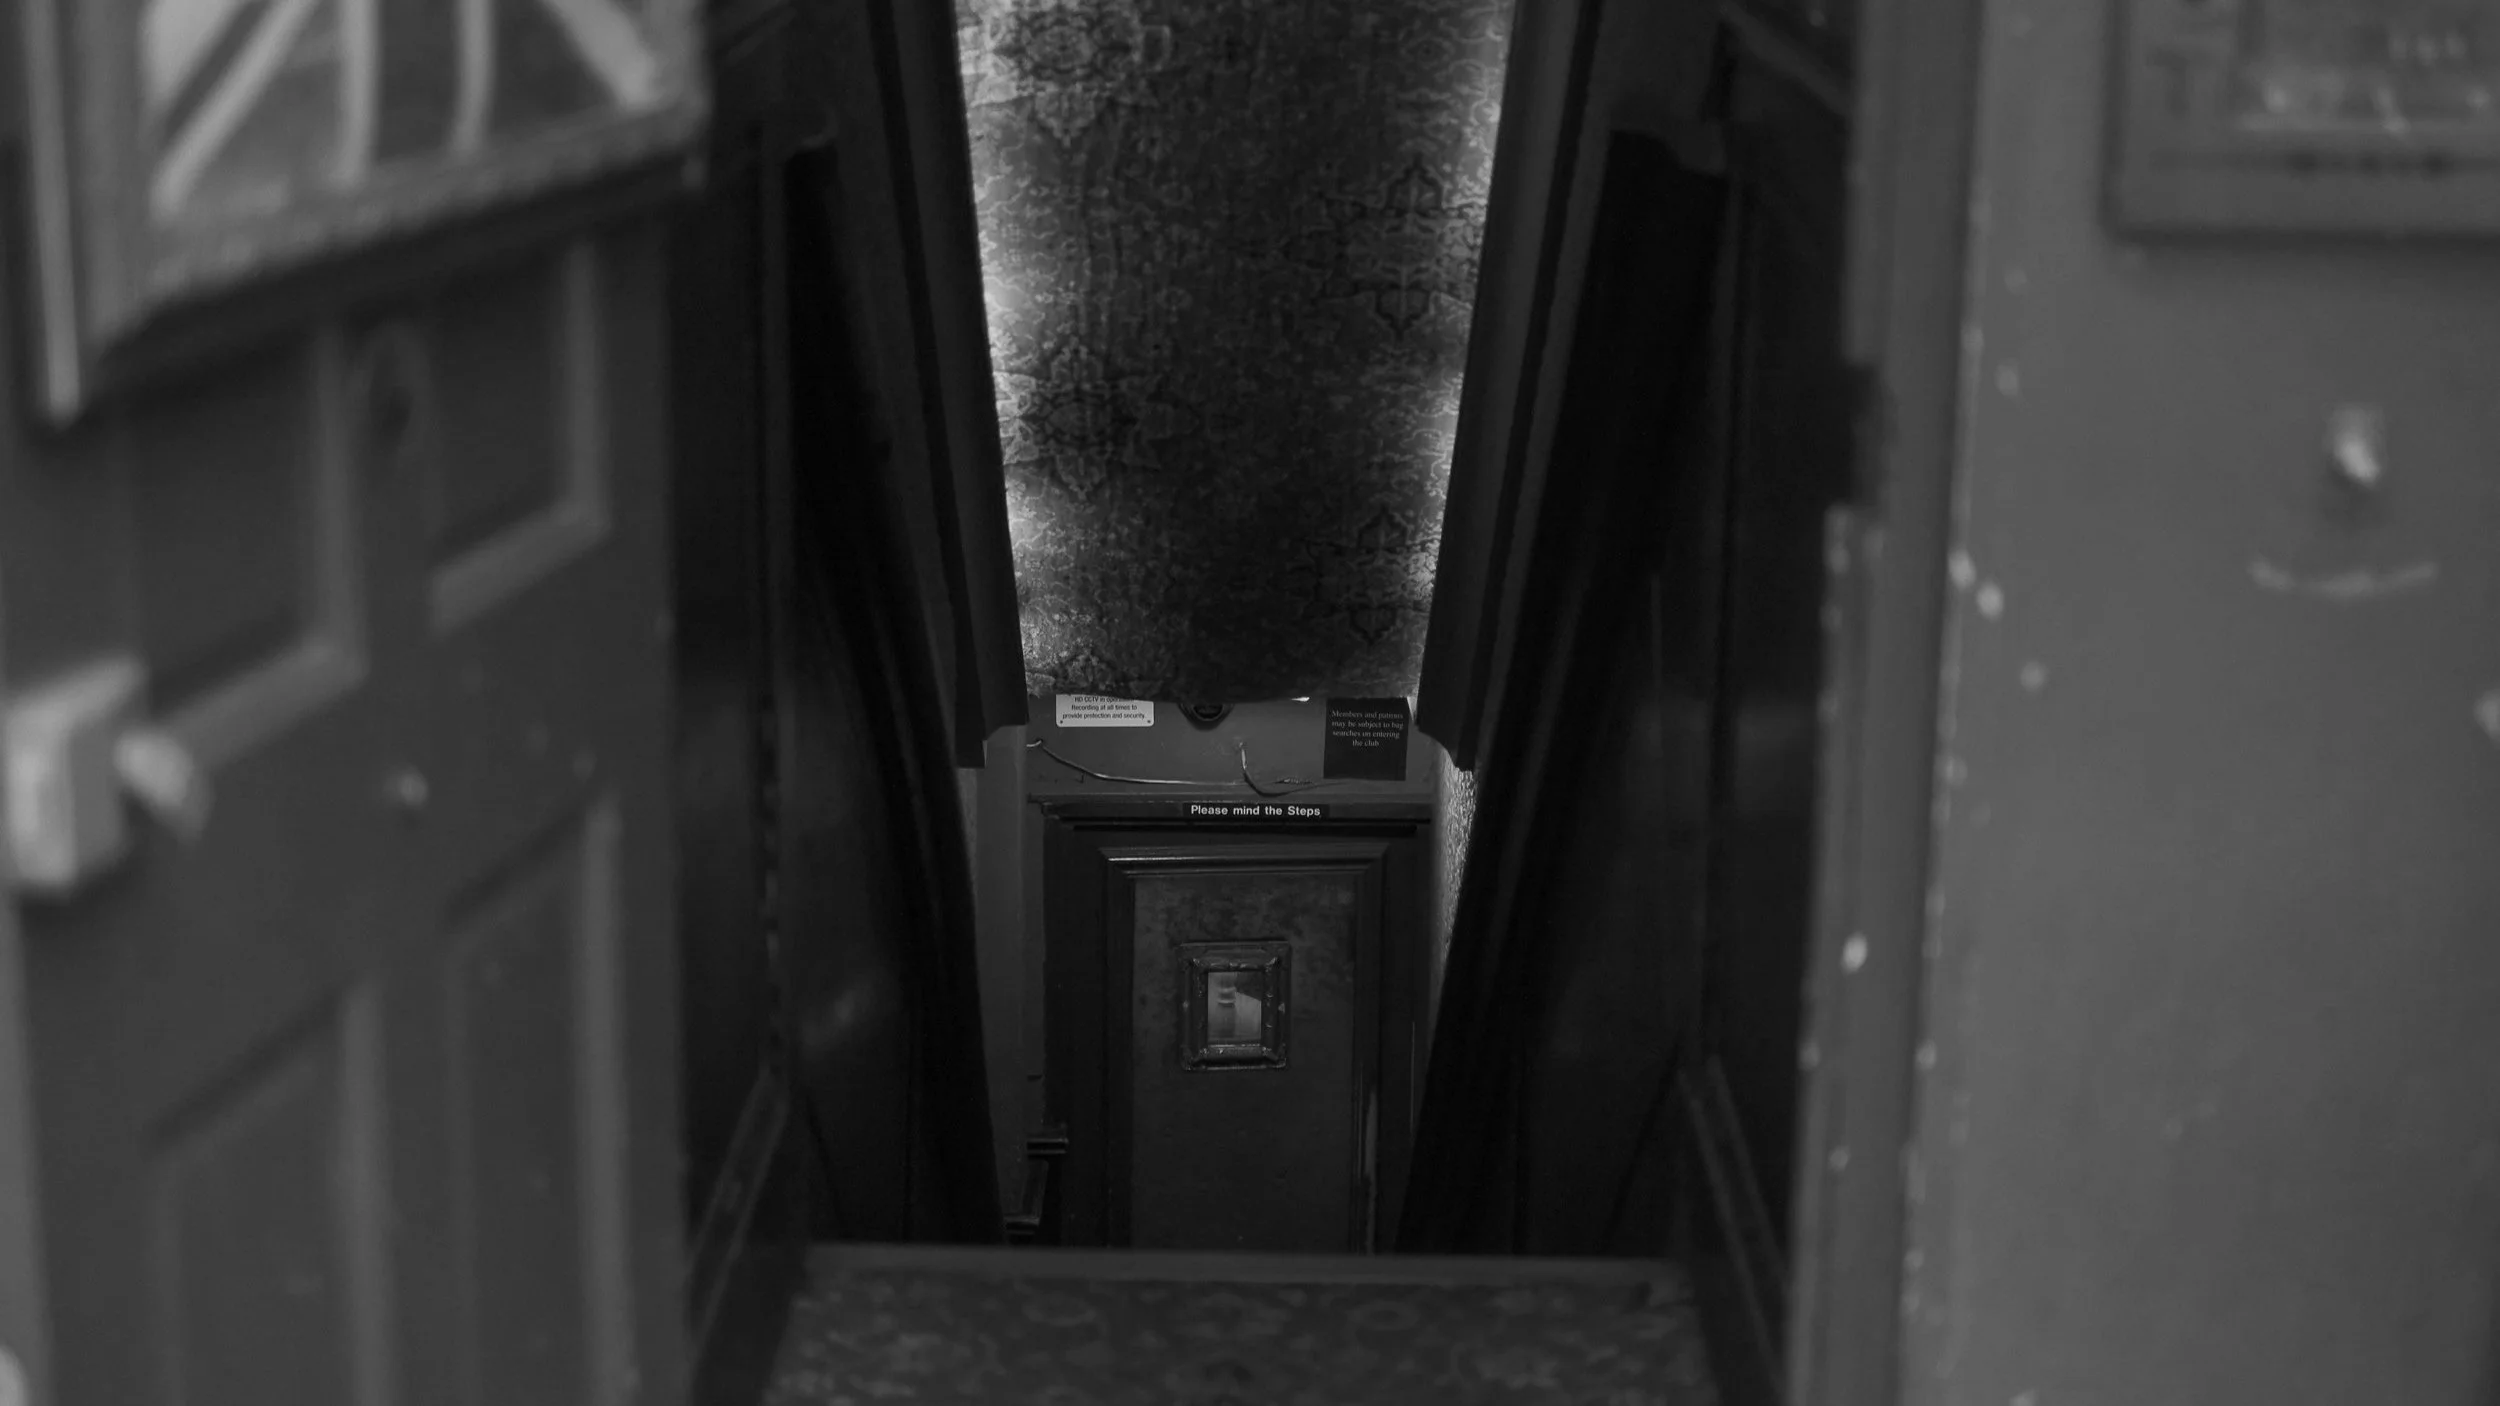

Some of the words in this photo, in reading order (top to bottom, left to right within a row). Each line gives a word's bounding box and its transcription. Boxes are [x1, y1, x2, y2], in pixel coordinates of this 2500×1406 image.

[1331, 710, 1363, 718] Members
[1364, 711, 1377, 719] and
[1358, 720, 1381, 729] subject
[1391, 721, 1404, 730] bag
[1372, 731, 1400, 740] entering
[1352, 739, 1363, 747] the
[1364, 739, 1380, 747] club
[1190, 804, 1228, 815] Please
[1233, 805, 1260, 815] mind
[1265, 805, 1283, 815] the
[1287, 805, 1321, 818] Steps
